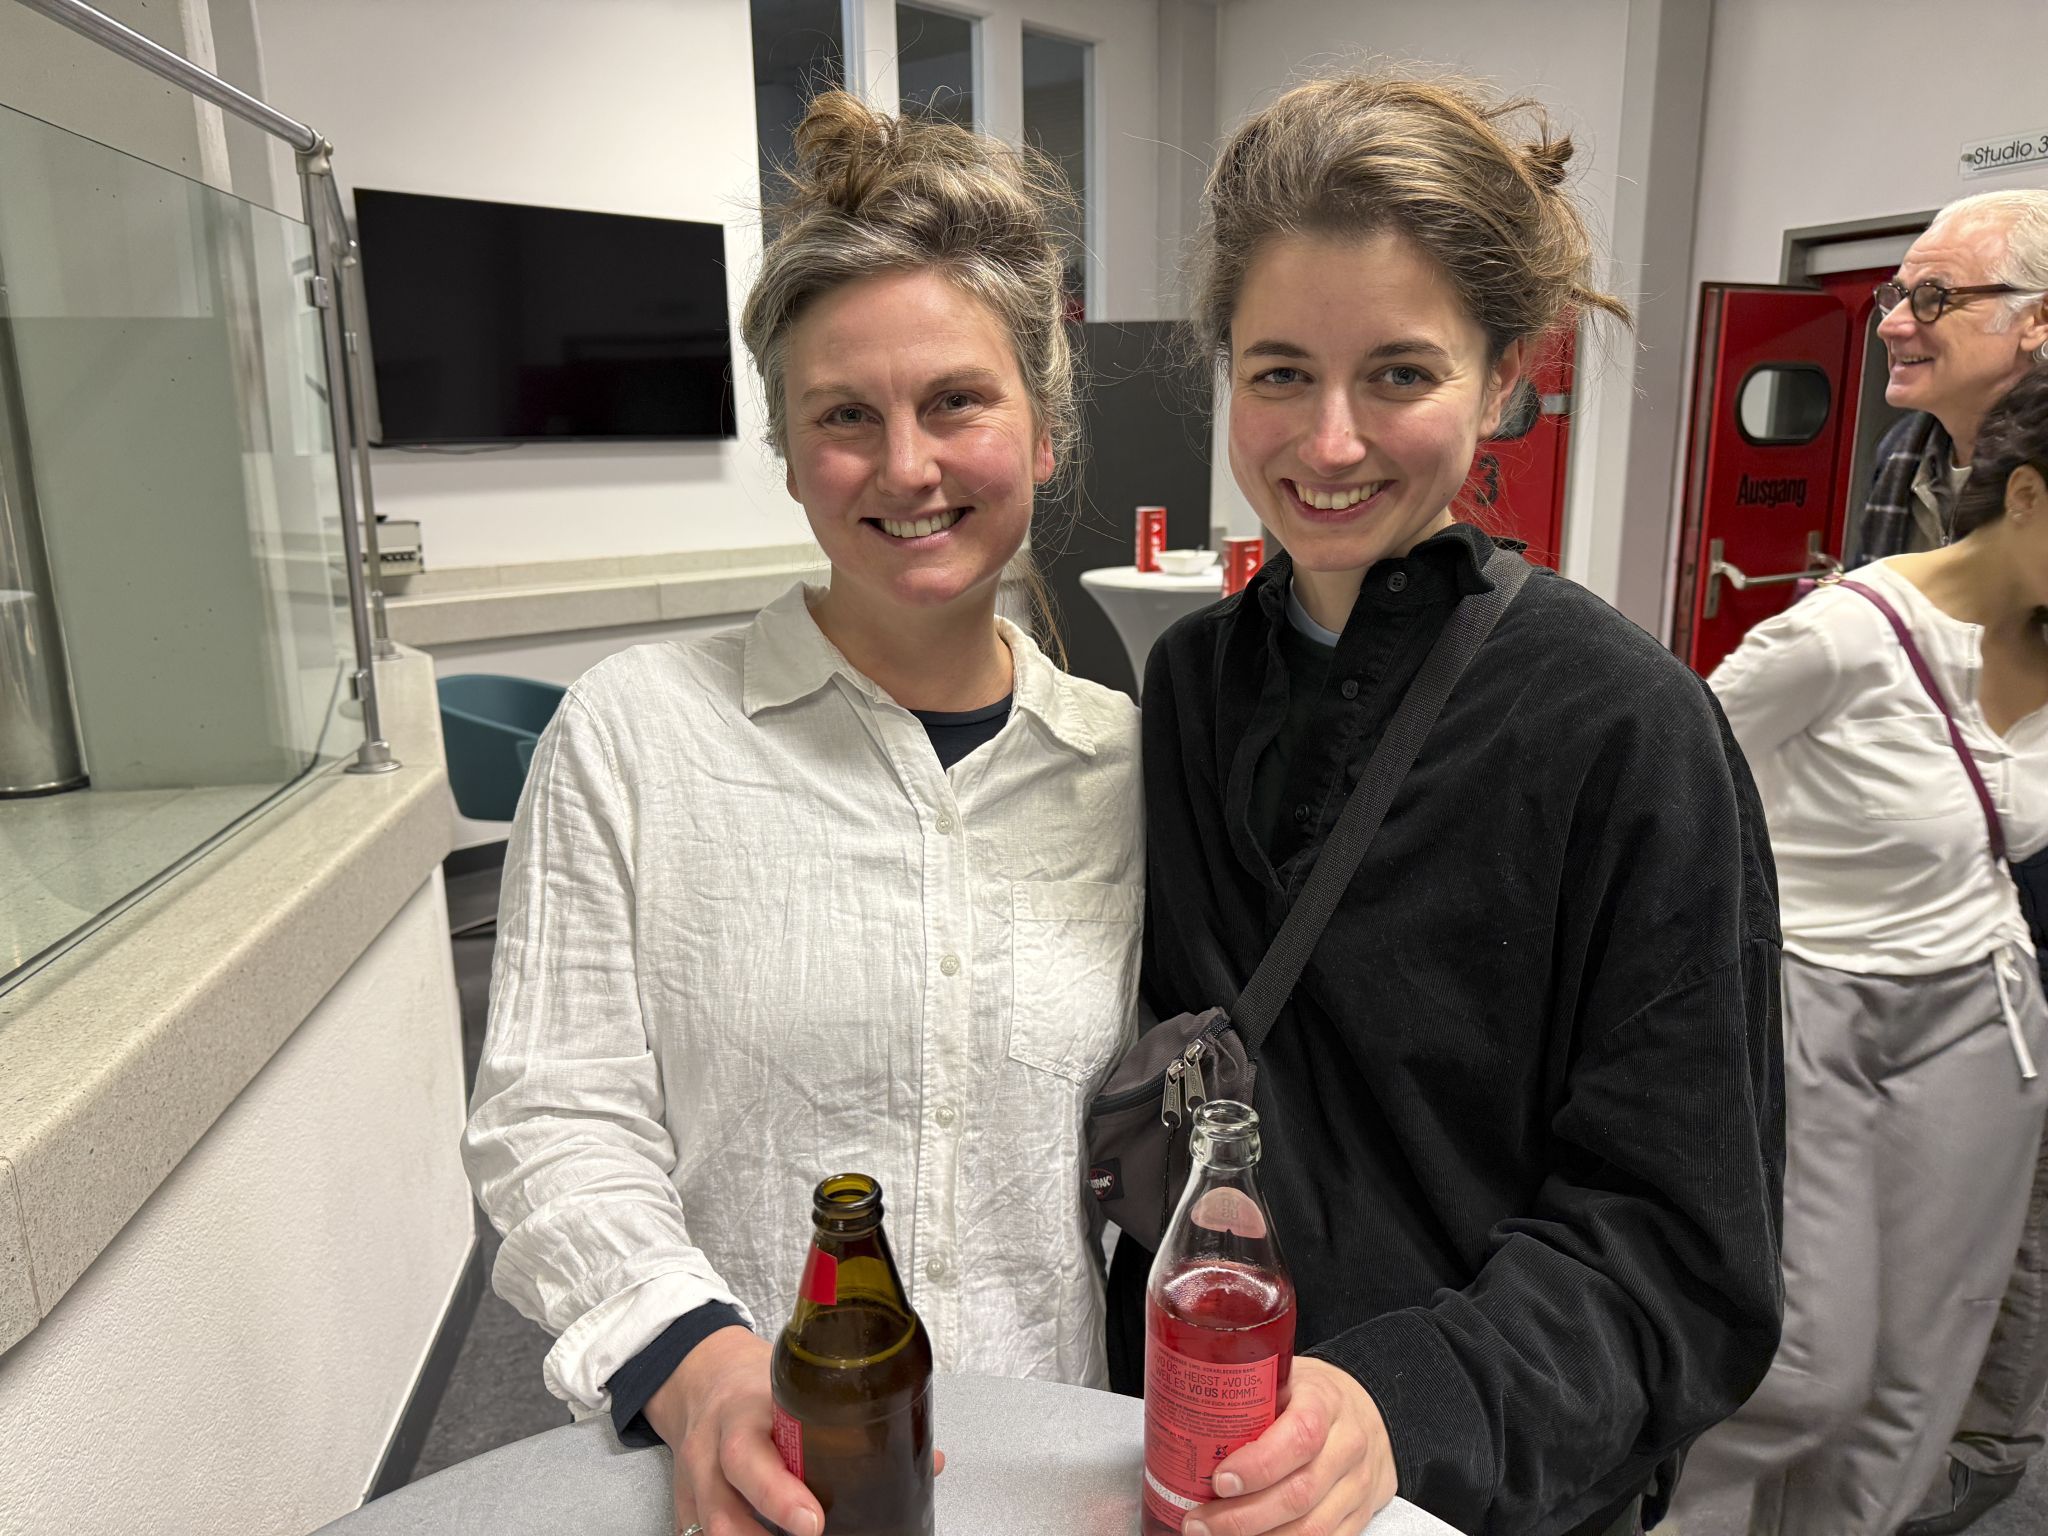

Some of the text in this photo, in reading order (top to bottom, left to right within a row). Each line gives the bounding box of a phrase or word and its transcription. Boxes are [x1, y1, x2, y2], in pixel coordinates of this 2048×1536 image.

[1974, 140, 2033, 165] Studio
[1475, 454, 1500, 507] 3
[1736, 473, 1808, 508] Ausgang
[1156, 1367, 1173, 1385] WEIL
[1174, 1377, 1186, 1391] ES
[1189, 1382, 1202, 1395] VO
[1222, 1386, 1258, 1400] KOMMT.
[1185, 1370, 1220, 1387] HEISST
